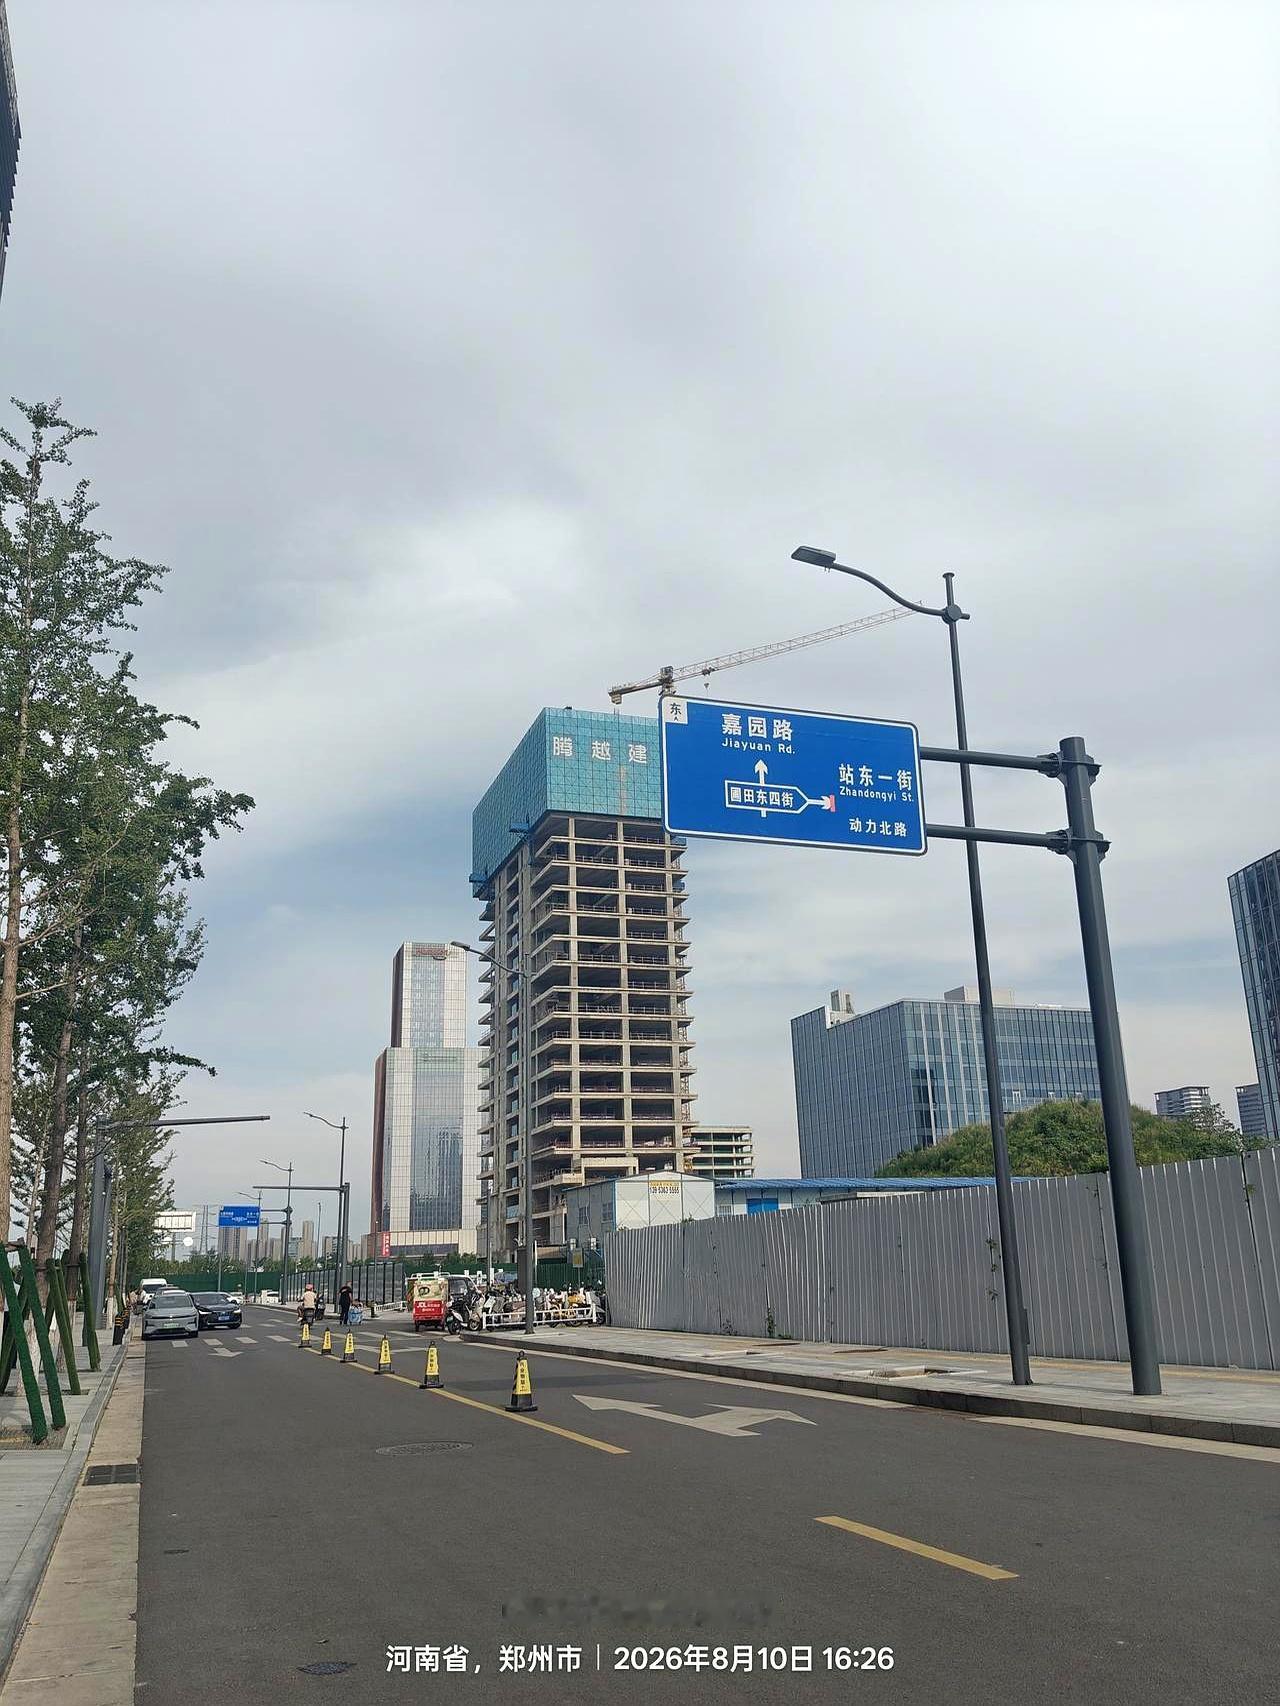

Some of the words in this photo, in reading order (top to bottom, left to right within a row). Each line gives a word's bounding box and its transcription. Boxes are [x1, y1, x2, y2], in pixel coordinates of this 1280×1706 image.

[670, 702, 682, 715] 东
[721, 713, 793, 741] 嘉园路
[721, 737, 771, 752] Jiayuan
[778, 743, 796, 755] Rd.
[839, 763, 913, 791] 站东一街
[839, 786, 897, 802] Zhandongyi
[902, 792, 914, 803] St.
[849, 818, 907, 837] 动力北路
